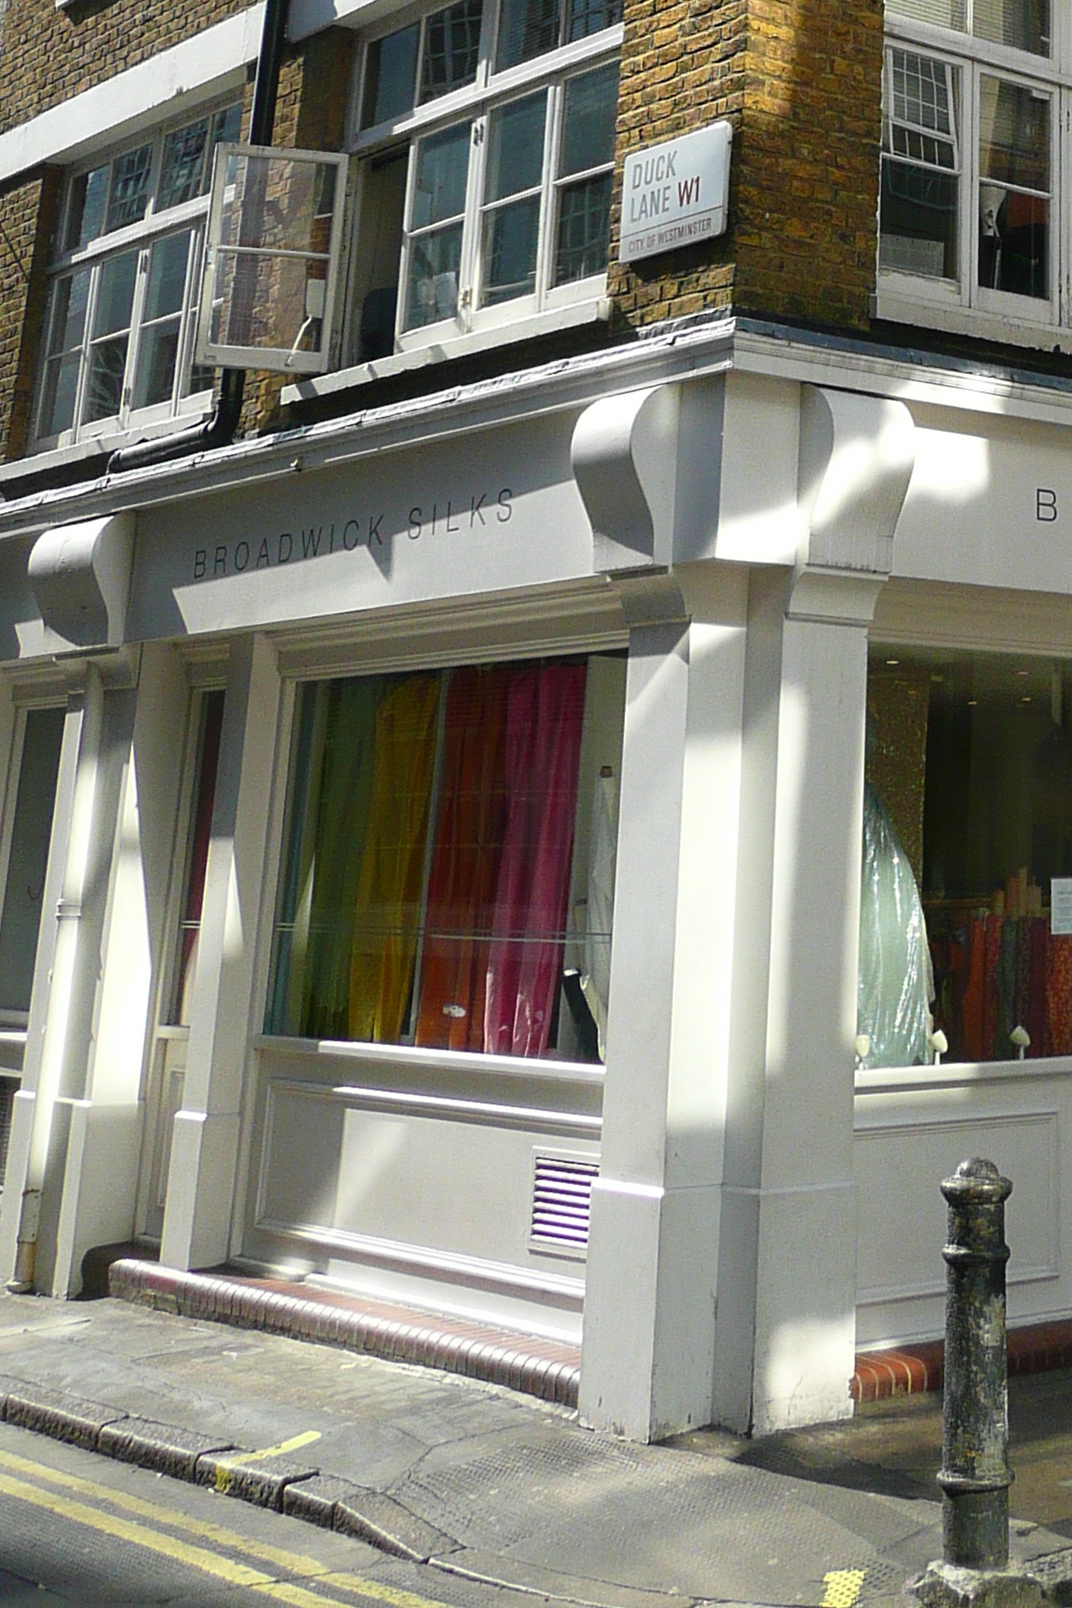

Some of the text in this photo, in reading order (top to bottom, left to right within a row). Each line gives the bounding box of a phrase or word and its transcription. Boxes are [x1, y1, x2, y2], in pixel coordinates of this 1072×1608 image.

[632, 150, 678, 190] DUCK
[630, 175, 700, 223] LANE W1
[628, 218, 712, 253] CITY OF WESTMINSTER
[193, 487, 514, 579] BROADWICK SILKS
